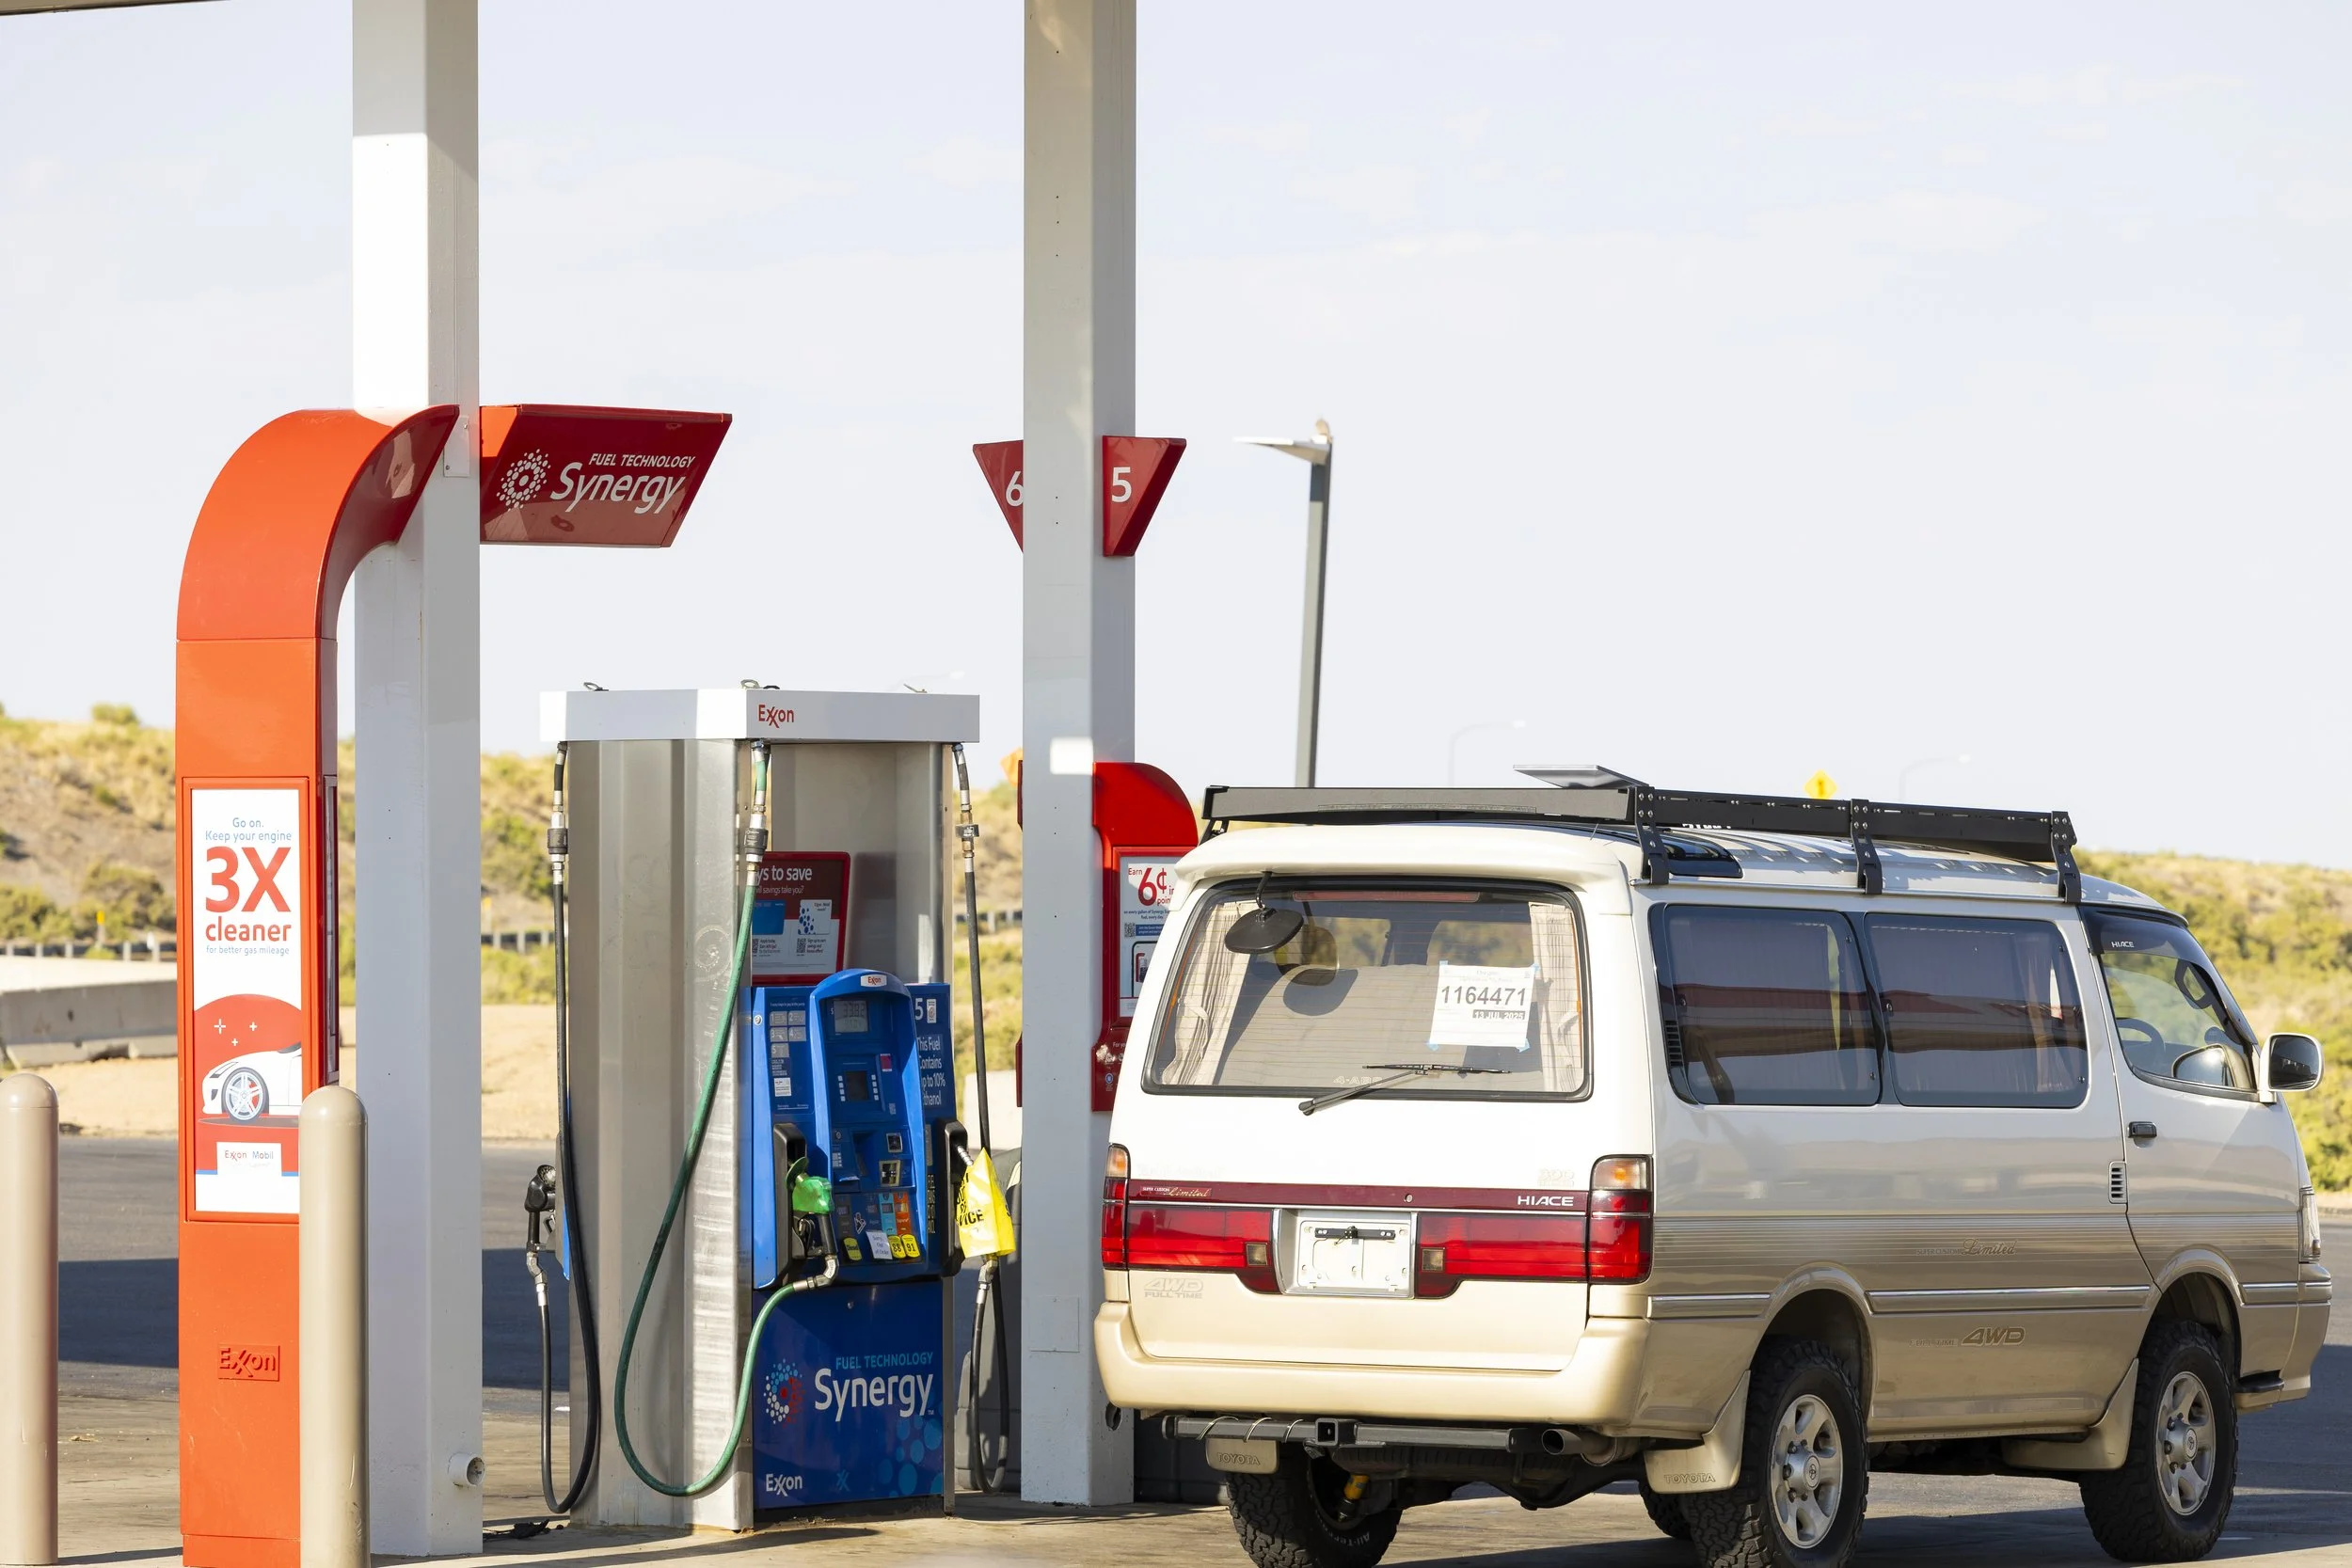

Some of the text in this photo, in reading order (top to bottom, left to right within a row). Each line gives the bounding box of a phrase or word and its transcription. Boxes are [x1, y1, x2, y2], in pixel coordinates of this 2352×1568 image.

[589, 453, 695, 468] FUEL TECHNOLOGY
[549, 462, 686, 514] Synergy
[1005, 470, 1024, 507] 6
[1112, 467, 1132, 502] 5
[758, 704, 794, 728] Exxon
[232, 817, 264, 828] Go on.
[205, 830, 293, 844] Keep your engine
[771, 865, 784, 880] to
[787, 867, 813, 880] save
[1128, 867, 1143, 876] Earn
[205, 846, 292, 913] 3X
[763, 886, 781, 896] savings
[781, 884, 792, 894] take
[205, 915, 292, 942] cleaner
[206, 945, 290, 956] for better gas mileage
[867, 976, 882, 985] Exxon
[1441, 986, 1526, 1006] 1164471
[915, 998, 924, 1021] 5
[1503, 1012, 1524, 1021] 2025
[929, 1037, 941, 1051] Fuel
[933, 1072, 946, 1087] 10%
[923, 1090, 942, 1106] thanol
[225, 1149, 274, 1162] Exxon Mobil
[1167, 1186, 1211, 1197] Limited
[1518, 1196, 1574, 1207] HIACE
[906, 1243, 916, 1252] 91
[1961, 1238, 2018, 1256] Limited
[1143, 1277, 1204, 1292] 4WD
[1961, 1326, 2026, 1346] 4WD
[219, 1347, 277, 1377] Exxon
[835, 1352, 933, 1370] FUEL TECHNOLOGY
[815, 1368, 933, 1422] Synergy
[1217, 1452, 1261, 1465] TOYOTA
[766, 1473, 803, 1497] Exxon
[1663, 1472, 1715, 1483] TOYOTA
